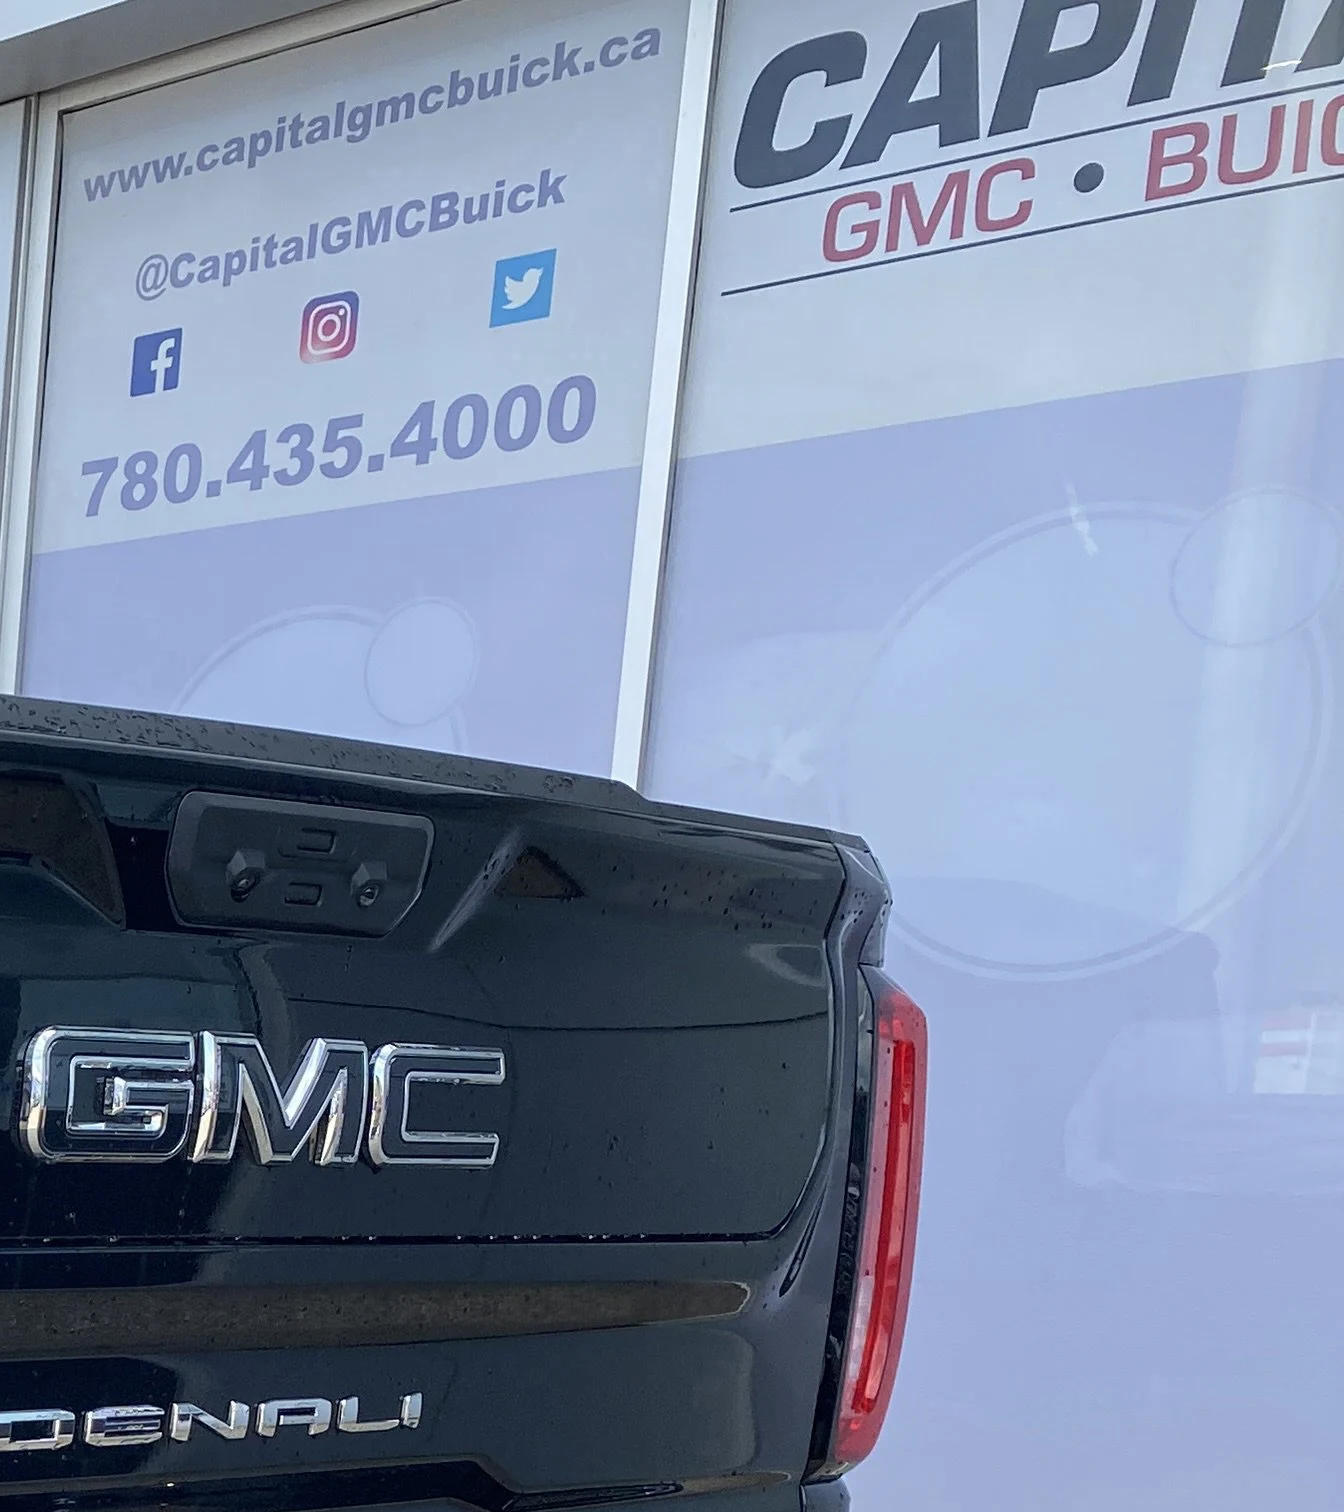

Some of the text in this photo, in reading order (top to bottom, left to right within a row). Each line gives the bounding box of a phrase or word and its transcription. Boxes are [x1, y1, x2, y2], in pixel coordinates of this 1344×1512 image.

[83, 26, 661, 203] www.capitalgmcbuick.ca
[134, 168, 569, 301] @CapitalGMCBuick
[822, 157, 1036, 263] GMC
[79, 374, 598, 518] 780.435.4000
[19, 1024, 505, 1169] GMC
